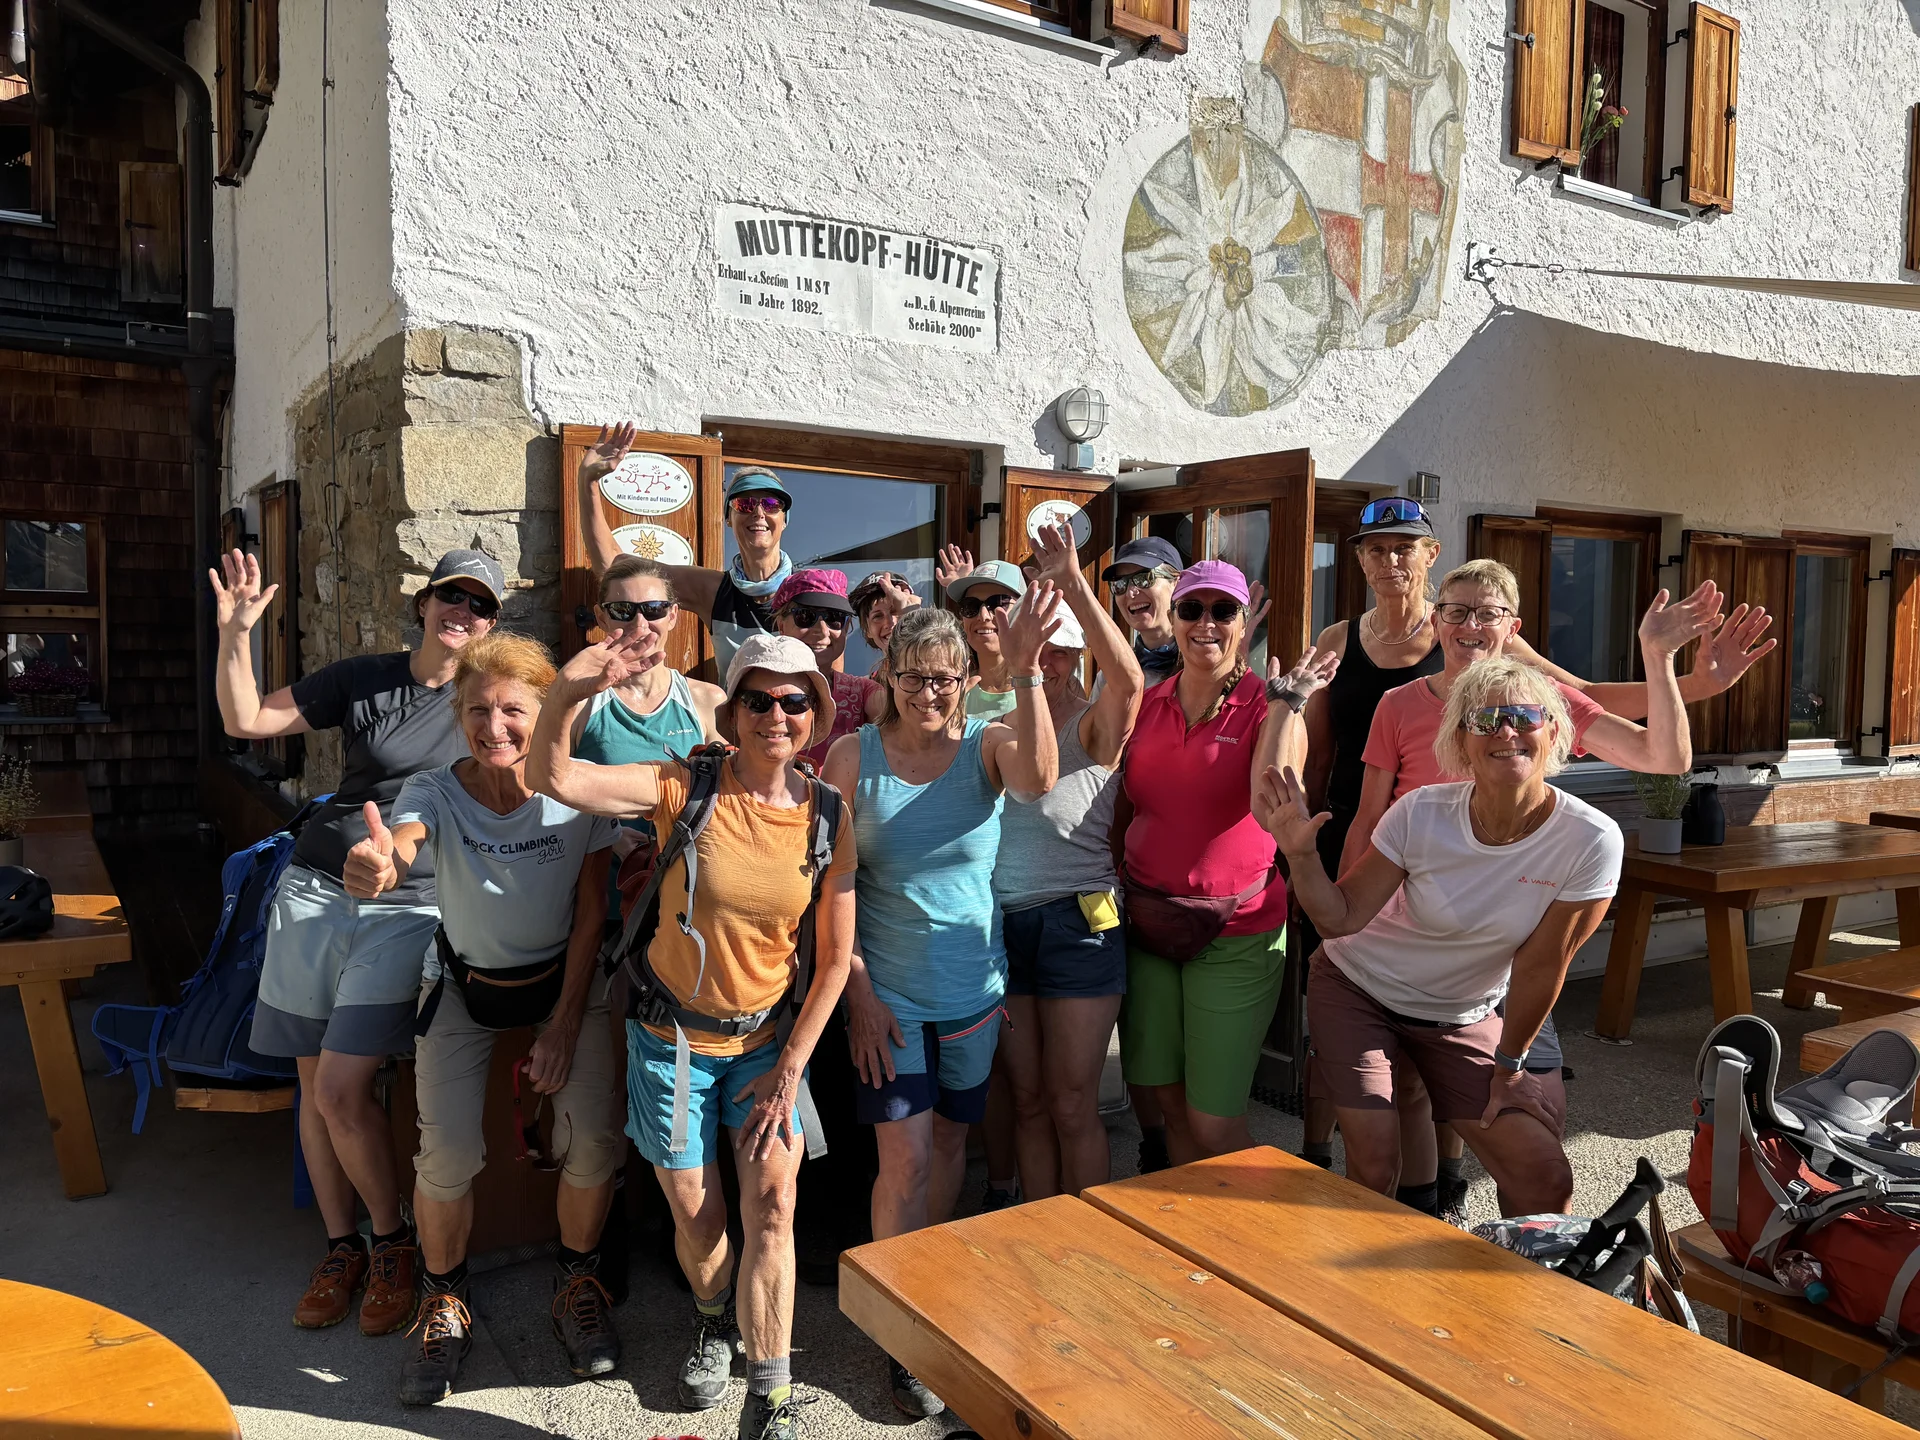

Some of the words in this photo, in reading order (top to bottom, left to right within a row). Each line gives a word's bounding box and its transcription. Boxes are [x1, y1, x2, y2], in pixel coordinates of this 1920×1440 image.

[735, 219, 983, 296] MUTTEKOPF-HÜTTE
[718, 263, 746, 281] Erbaut
[739, 289, 752, 305] im
[758, 292, 785, 310] Jahre
[792, 298, 822, 315] 1892.
[939, 300, 985, 320] Alpenvereins
[908, 316, 946, 335] Seehöhe
[462, 835, 496, 855] ROCK
[499, 834, 558, 854] CLIMBING
[537, 838, 566, 865] girl
[1530, 878, 1557, 888] VAUDE
